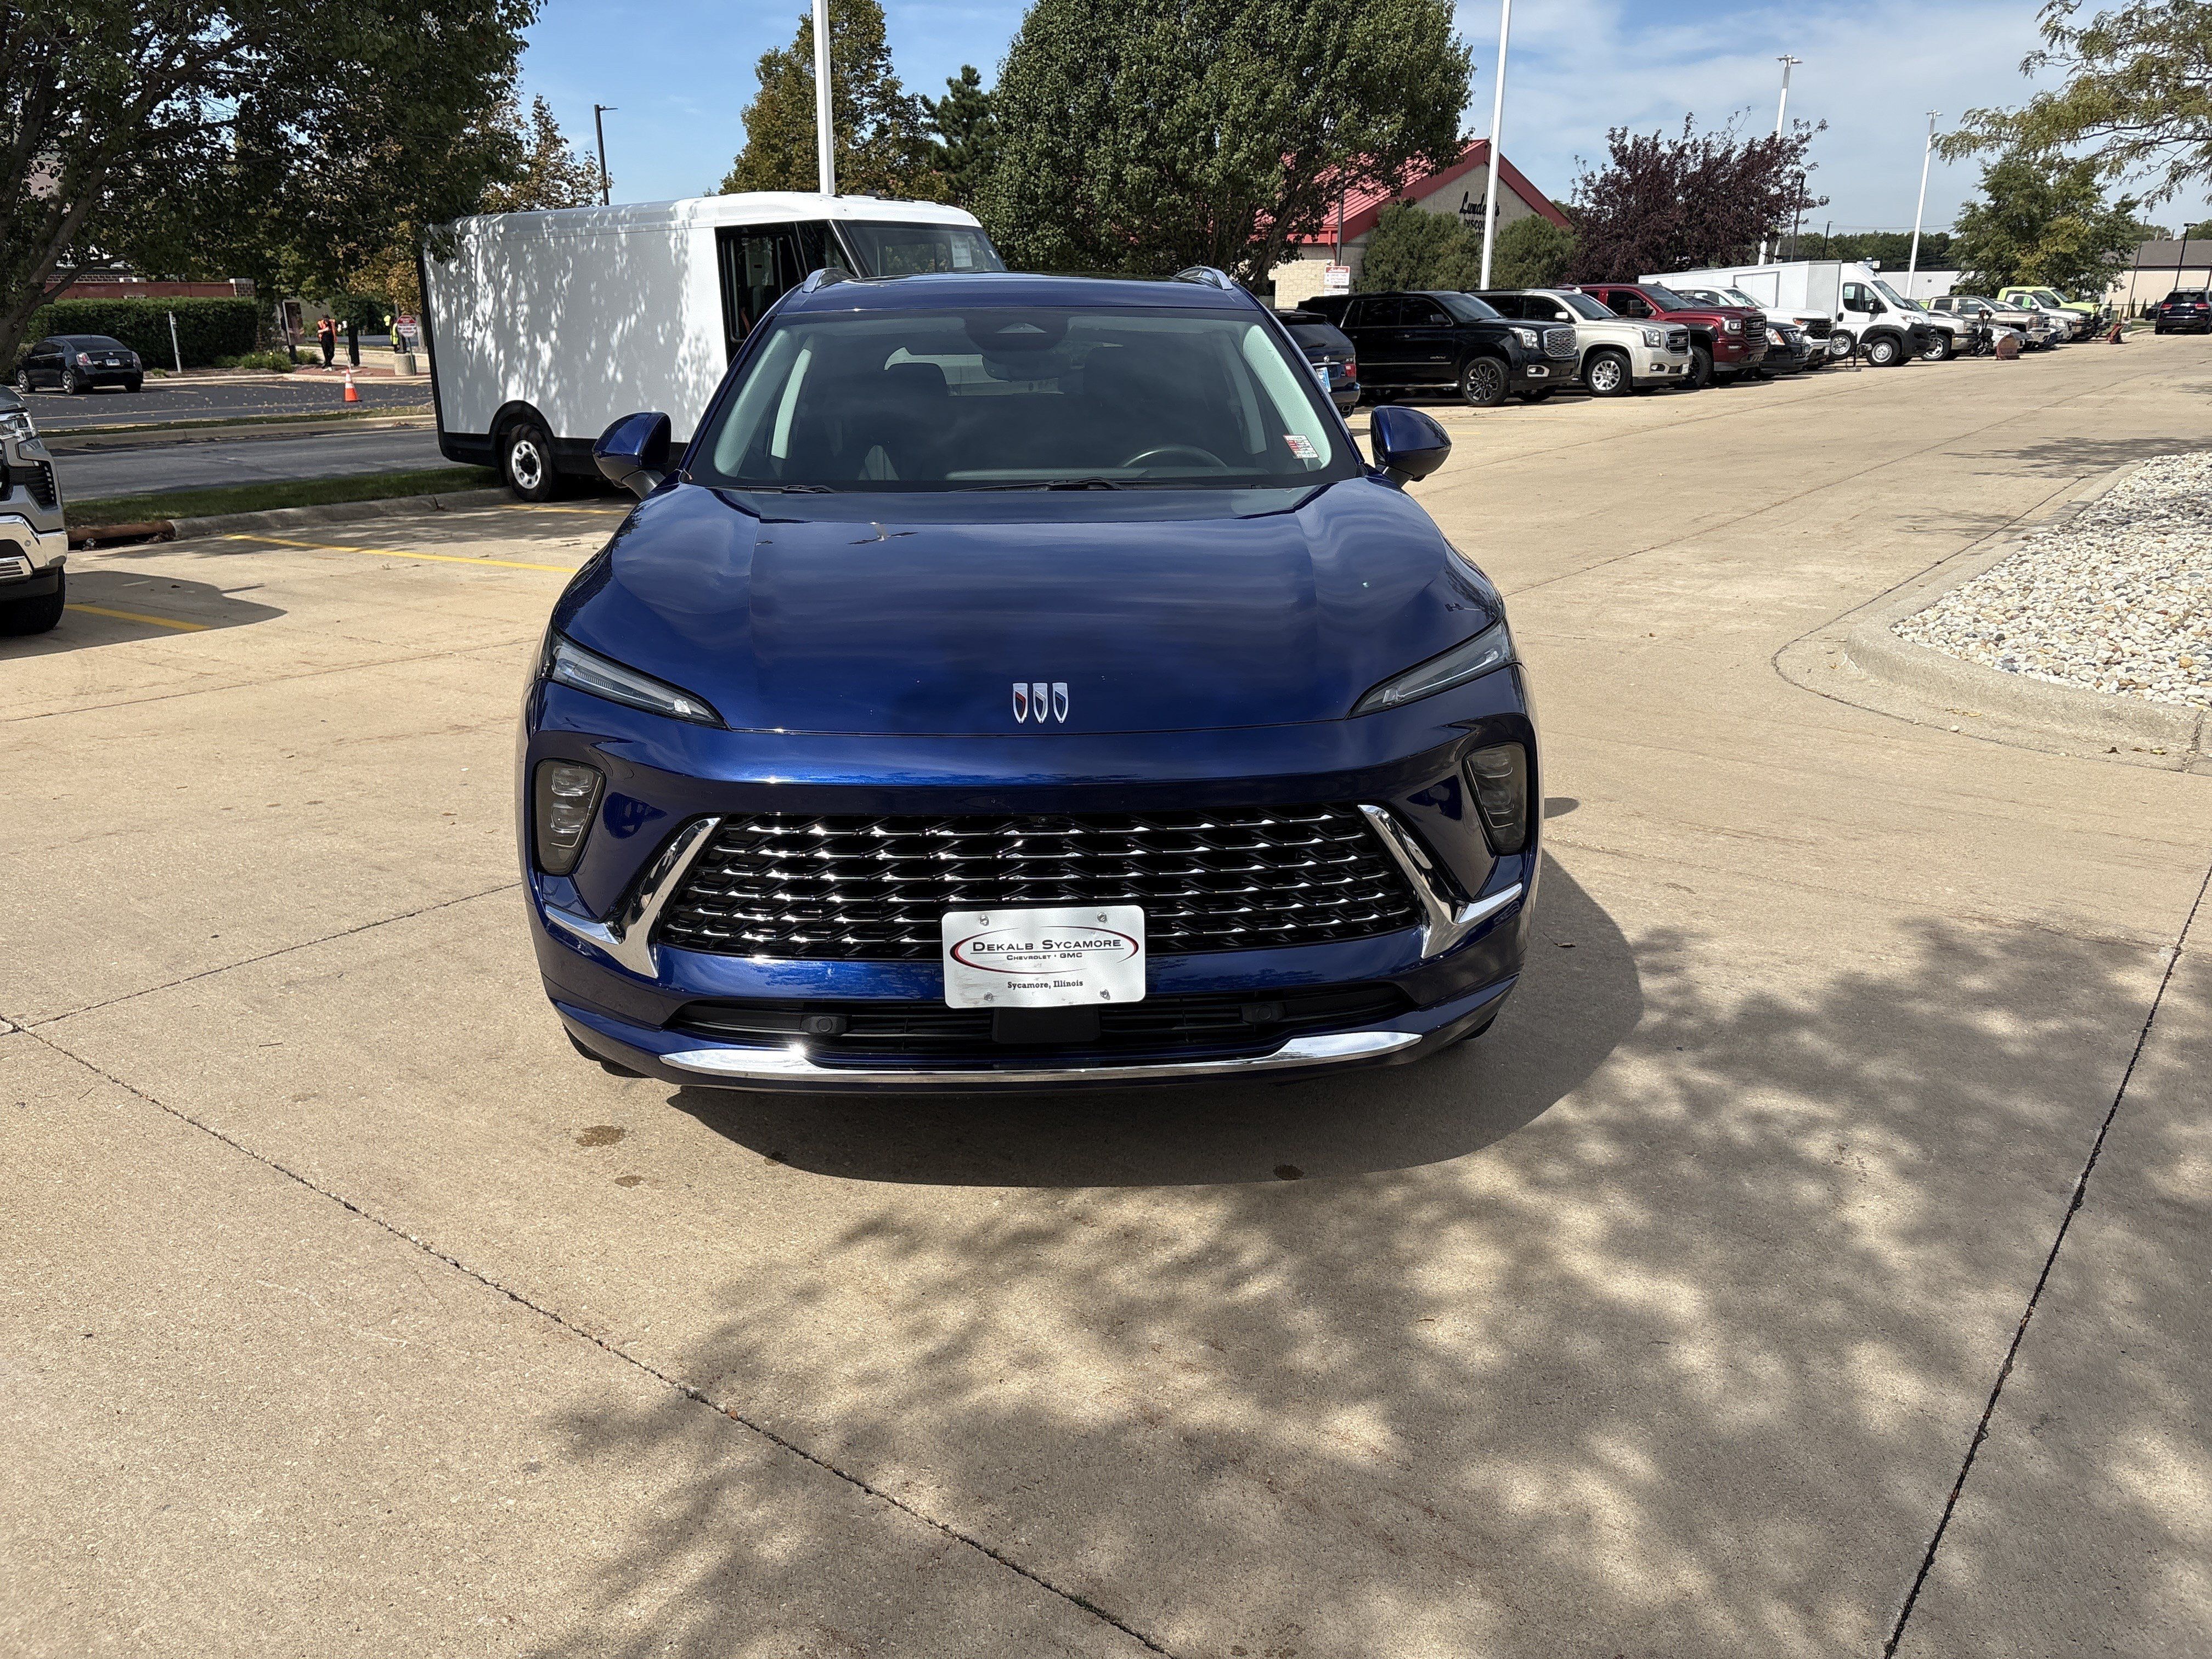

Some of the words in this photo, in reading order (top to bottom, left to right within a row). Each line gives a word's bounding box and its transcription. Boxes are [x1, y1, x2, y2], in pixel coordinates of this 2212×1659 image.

[973, 941, 1034, 951] DEKALB
[1042, 939, 1121, 949] SYCAMORE
[1007, 981, 1051, 990] Sycamore,
[1053, 979, 1084, 988] Illinois
